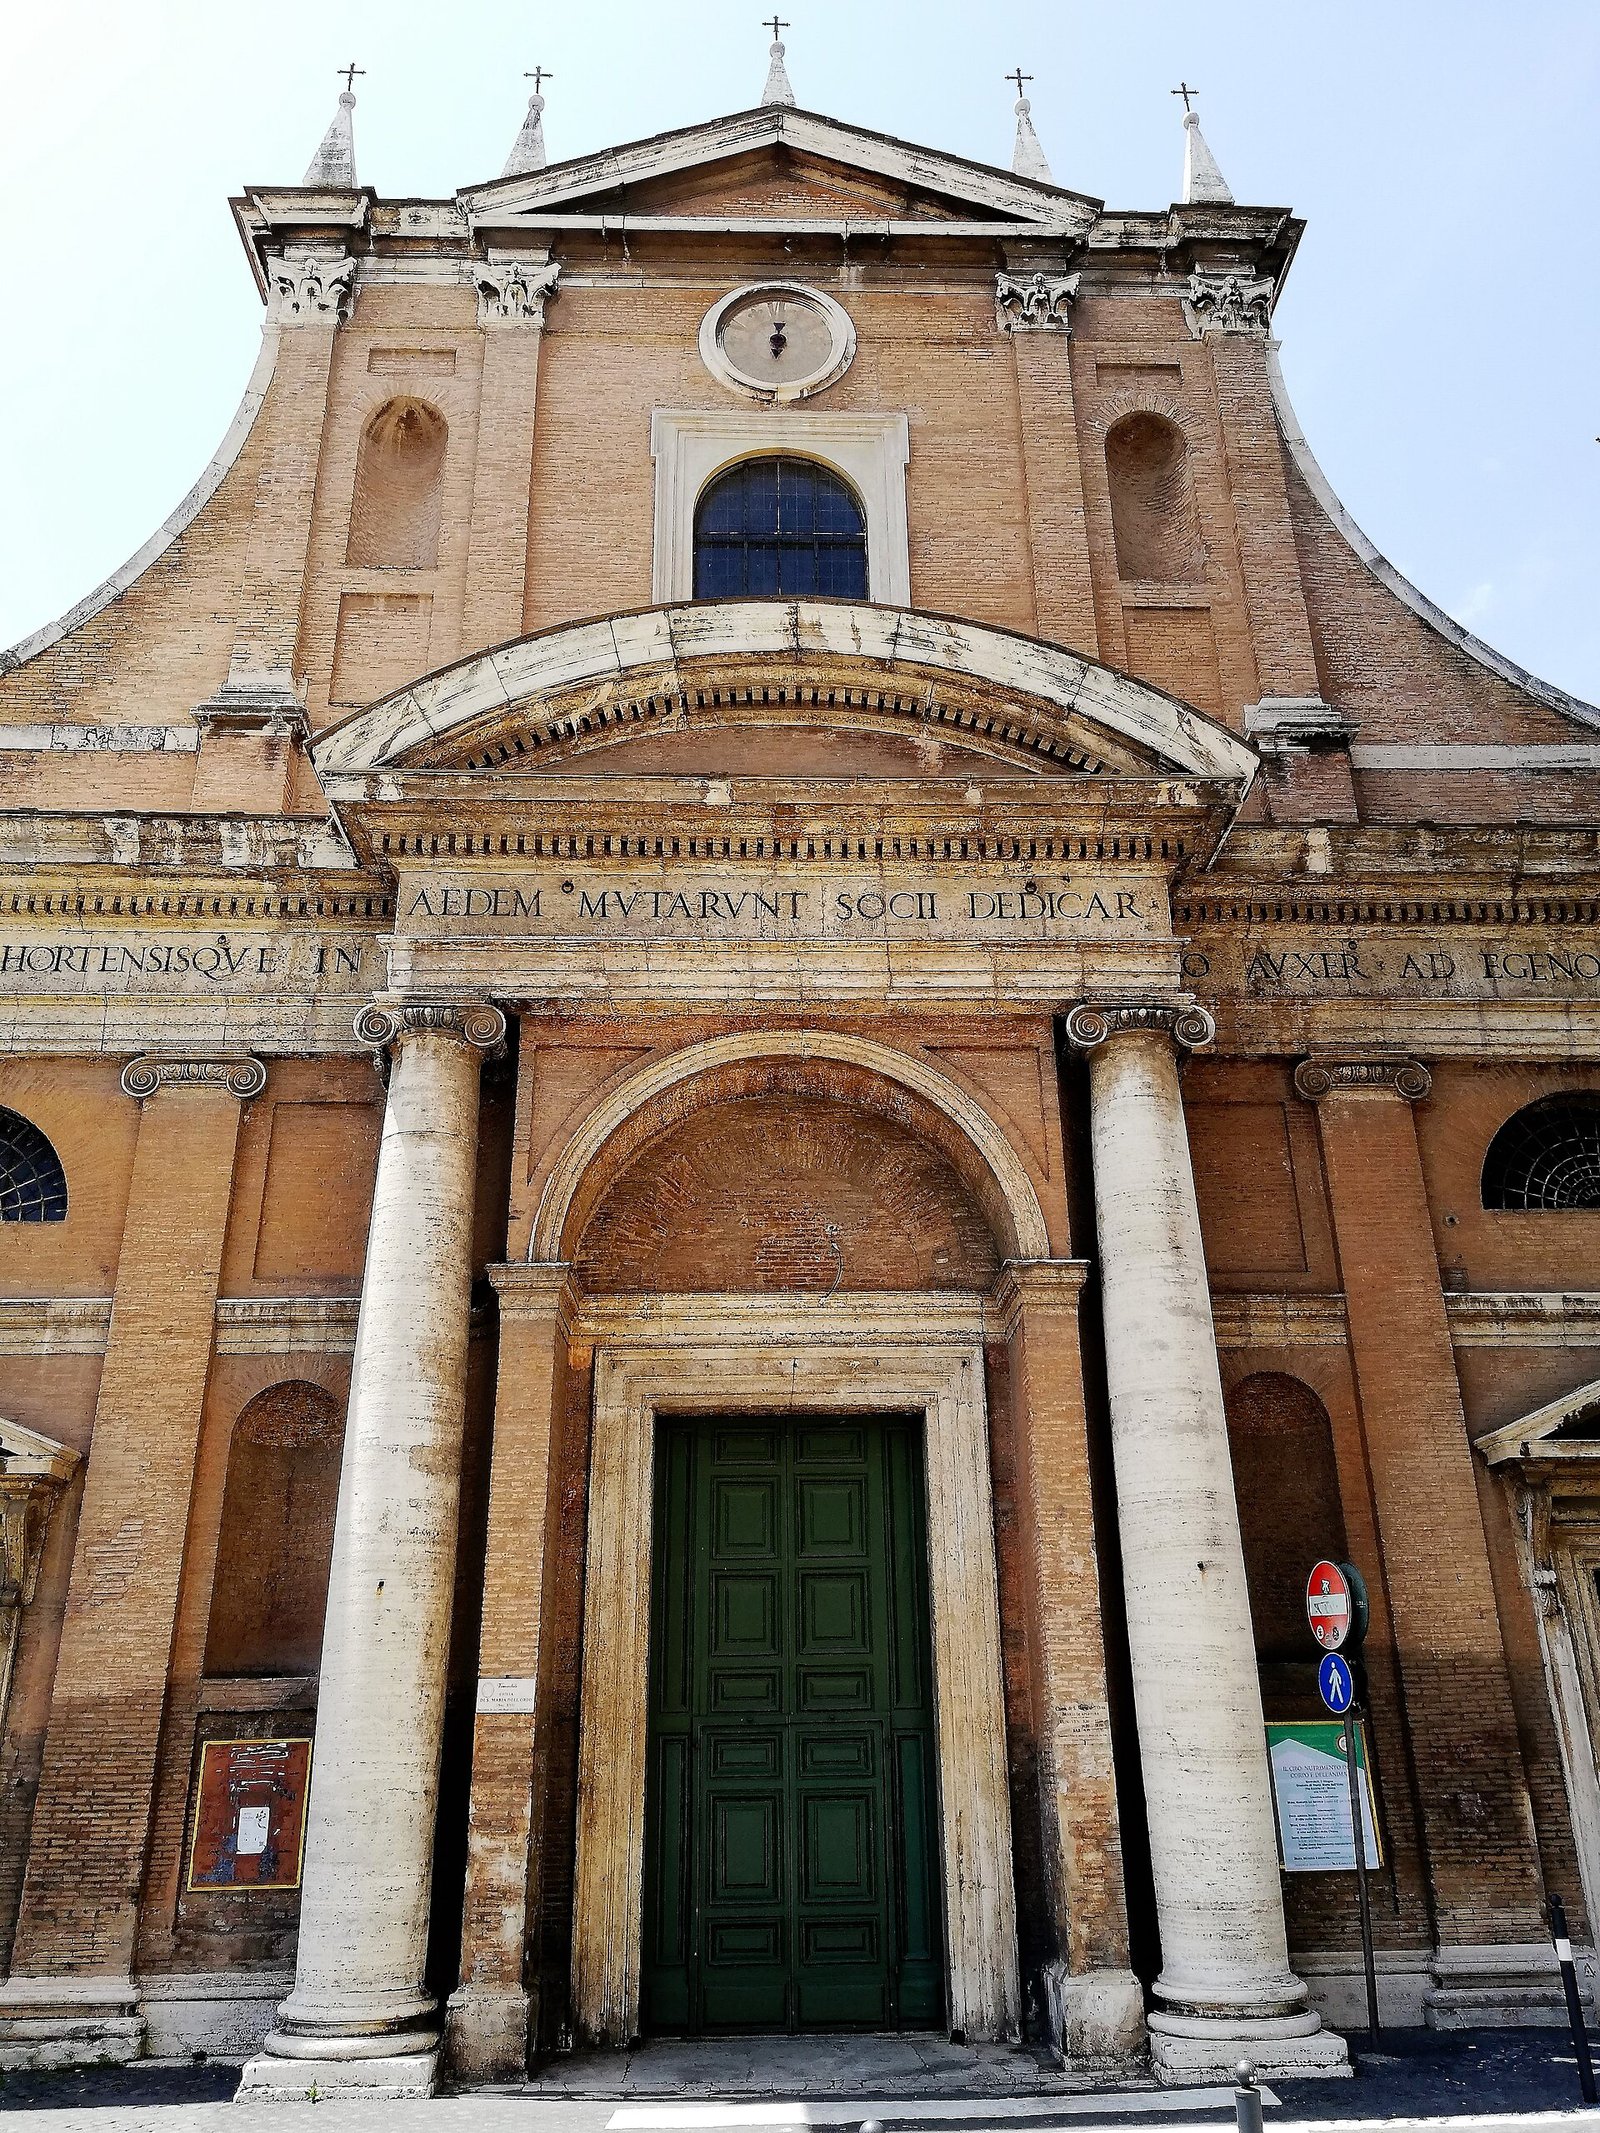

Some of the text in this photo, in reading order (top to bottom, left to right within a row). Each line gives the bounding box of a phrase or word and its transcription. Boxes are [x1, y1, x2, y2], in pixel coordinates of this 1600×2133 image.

[408, 888, 1144, 920] AEDEM MVTARVNT SOCII DEDICAR
[314, 946, 364, 974] IN
[1401, 952, 1456, 980] AD
